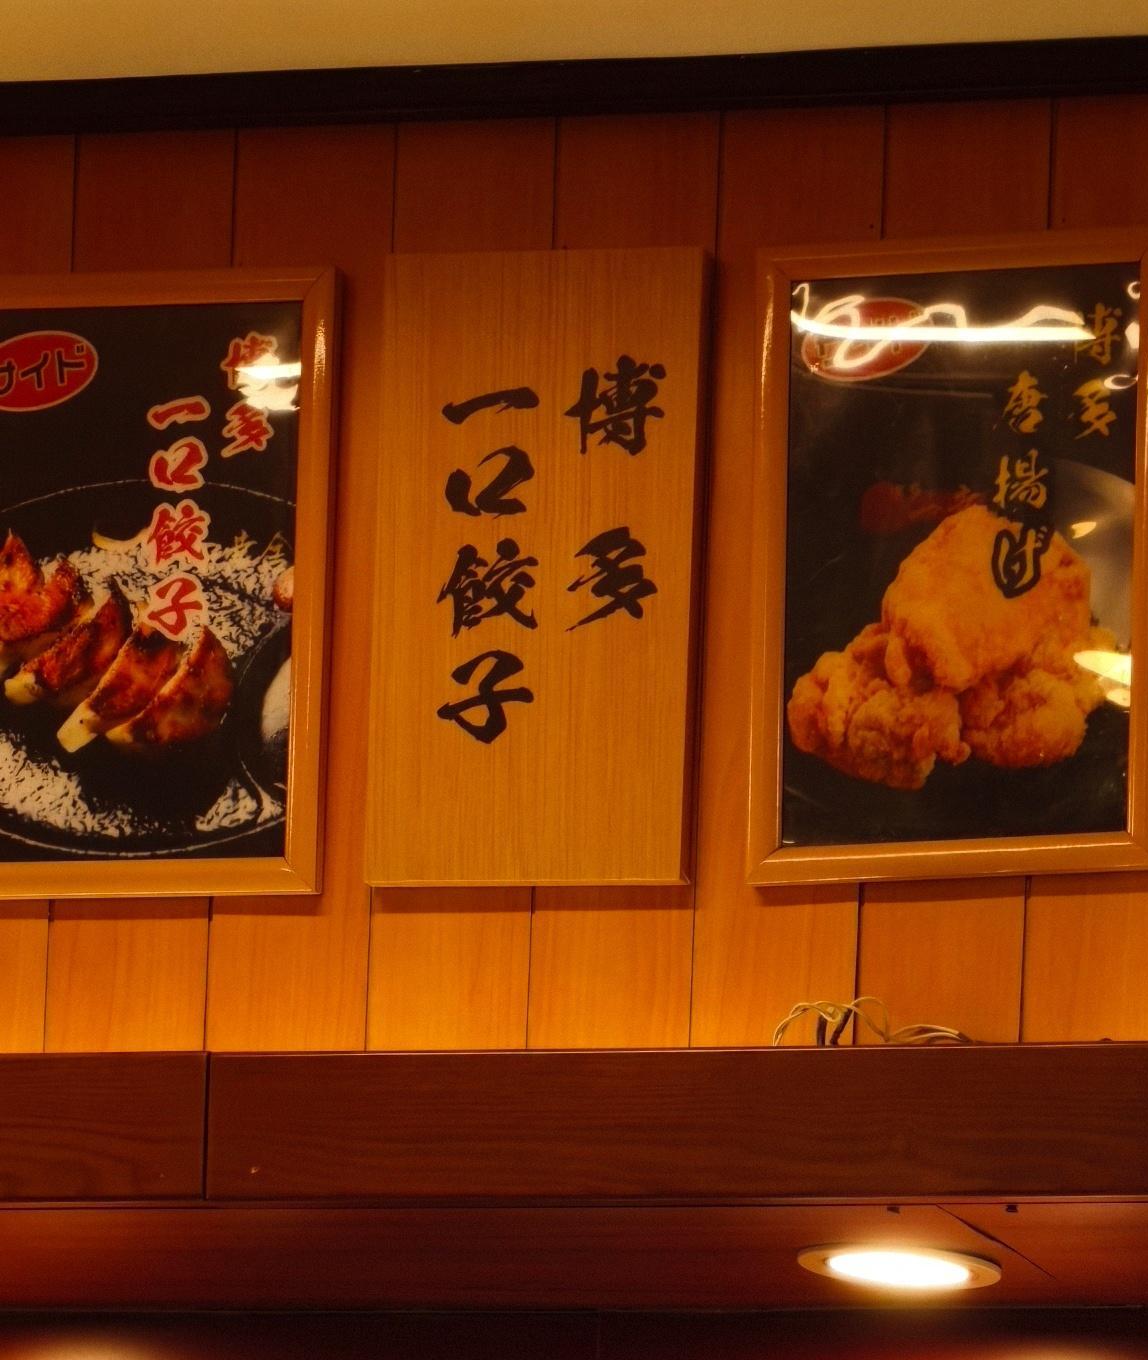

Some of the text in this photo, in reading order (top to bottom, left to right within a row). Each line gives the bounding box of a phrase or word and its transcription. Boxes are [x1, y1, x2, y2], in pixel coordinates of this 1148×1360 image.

[146, 396, 211, 640] 一口餃子
[436, 386, 540, 745] 一口餃子
[564, 355, 668, 632] 博多
[992, 370, 1052, 599] 唐揚げ
